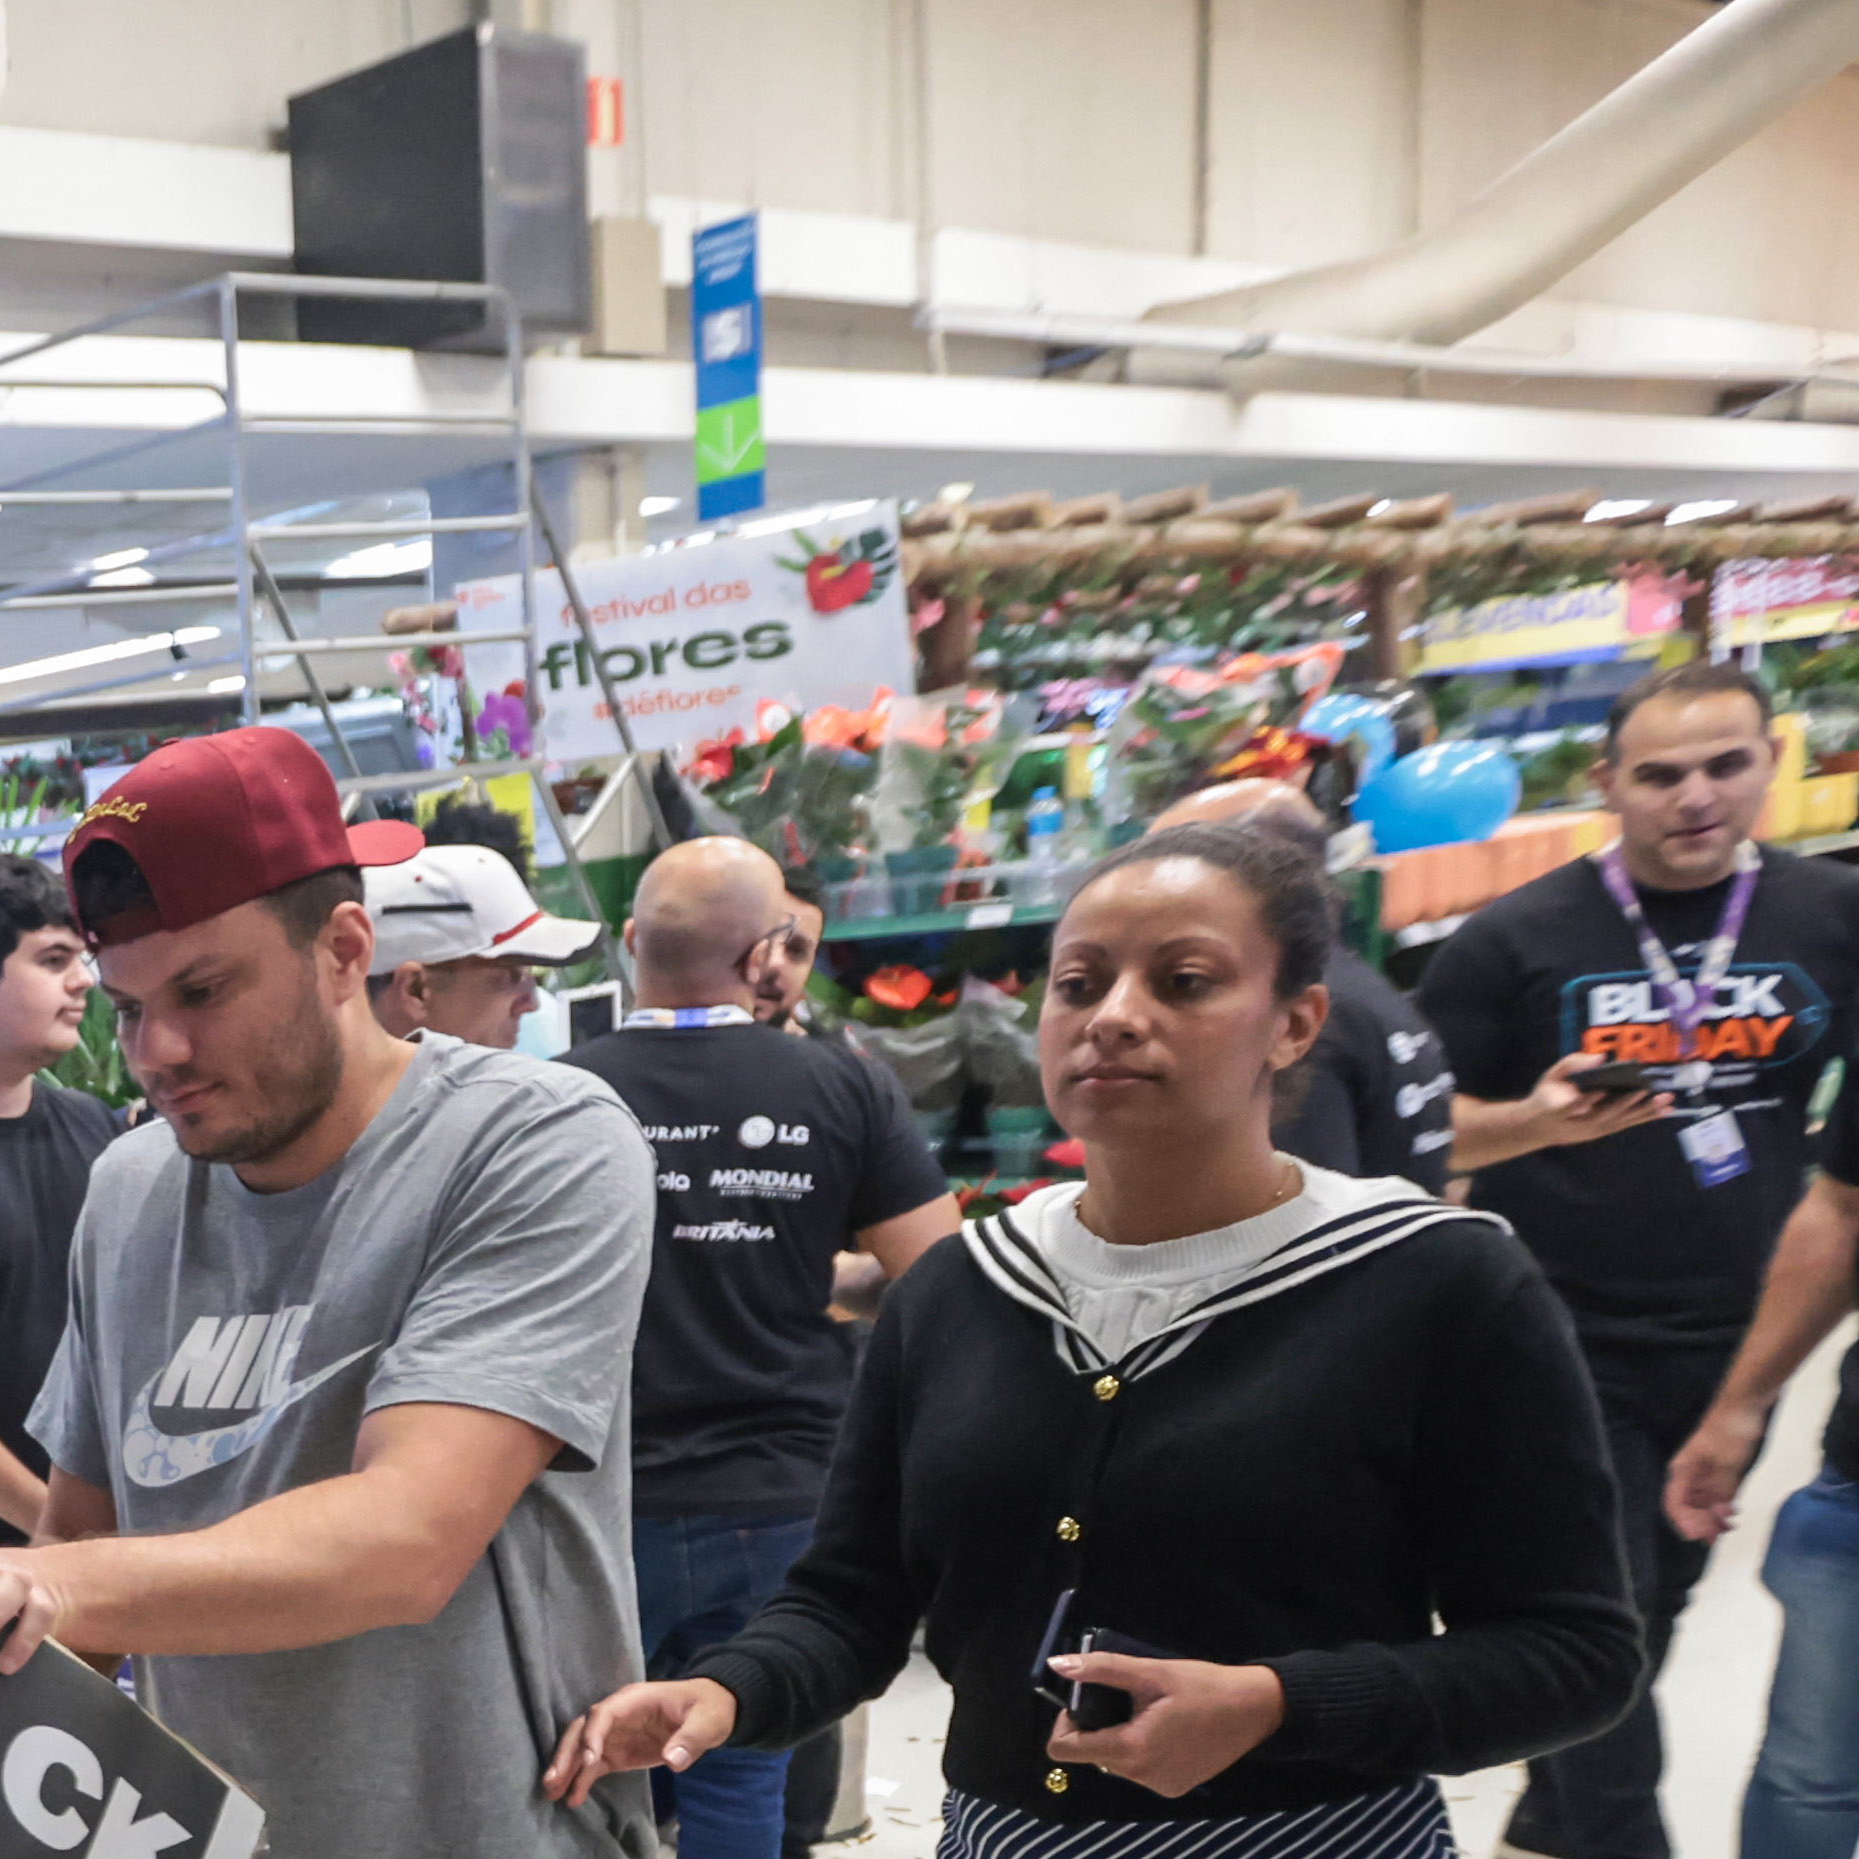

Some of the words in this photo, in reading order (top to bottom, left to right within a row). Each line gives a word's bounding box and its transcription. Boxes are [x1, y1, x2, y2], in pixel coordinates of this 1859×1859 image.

[561, 586, 676, 629] fstival
[685, 578, 751, 608] das
[538, 620, 794, 691] flores
[777, 1123, 811, 1147] LG
[709, 1168, 815, 1191] MONDIAL
